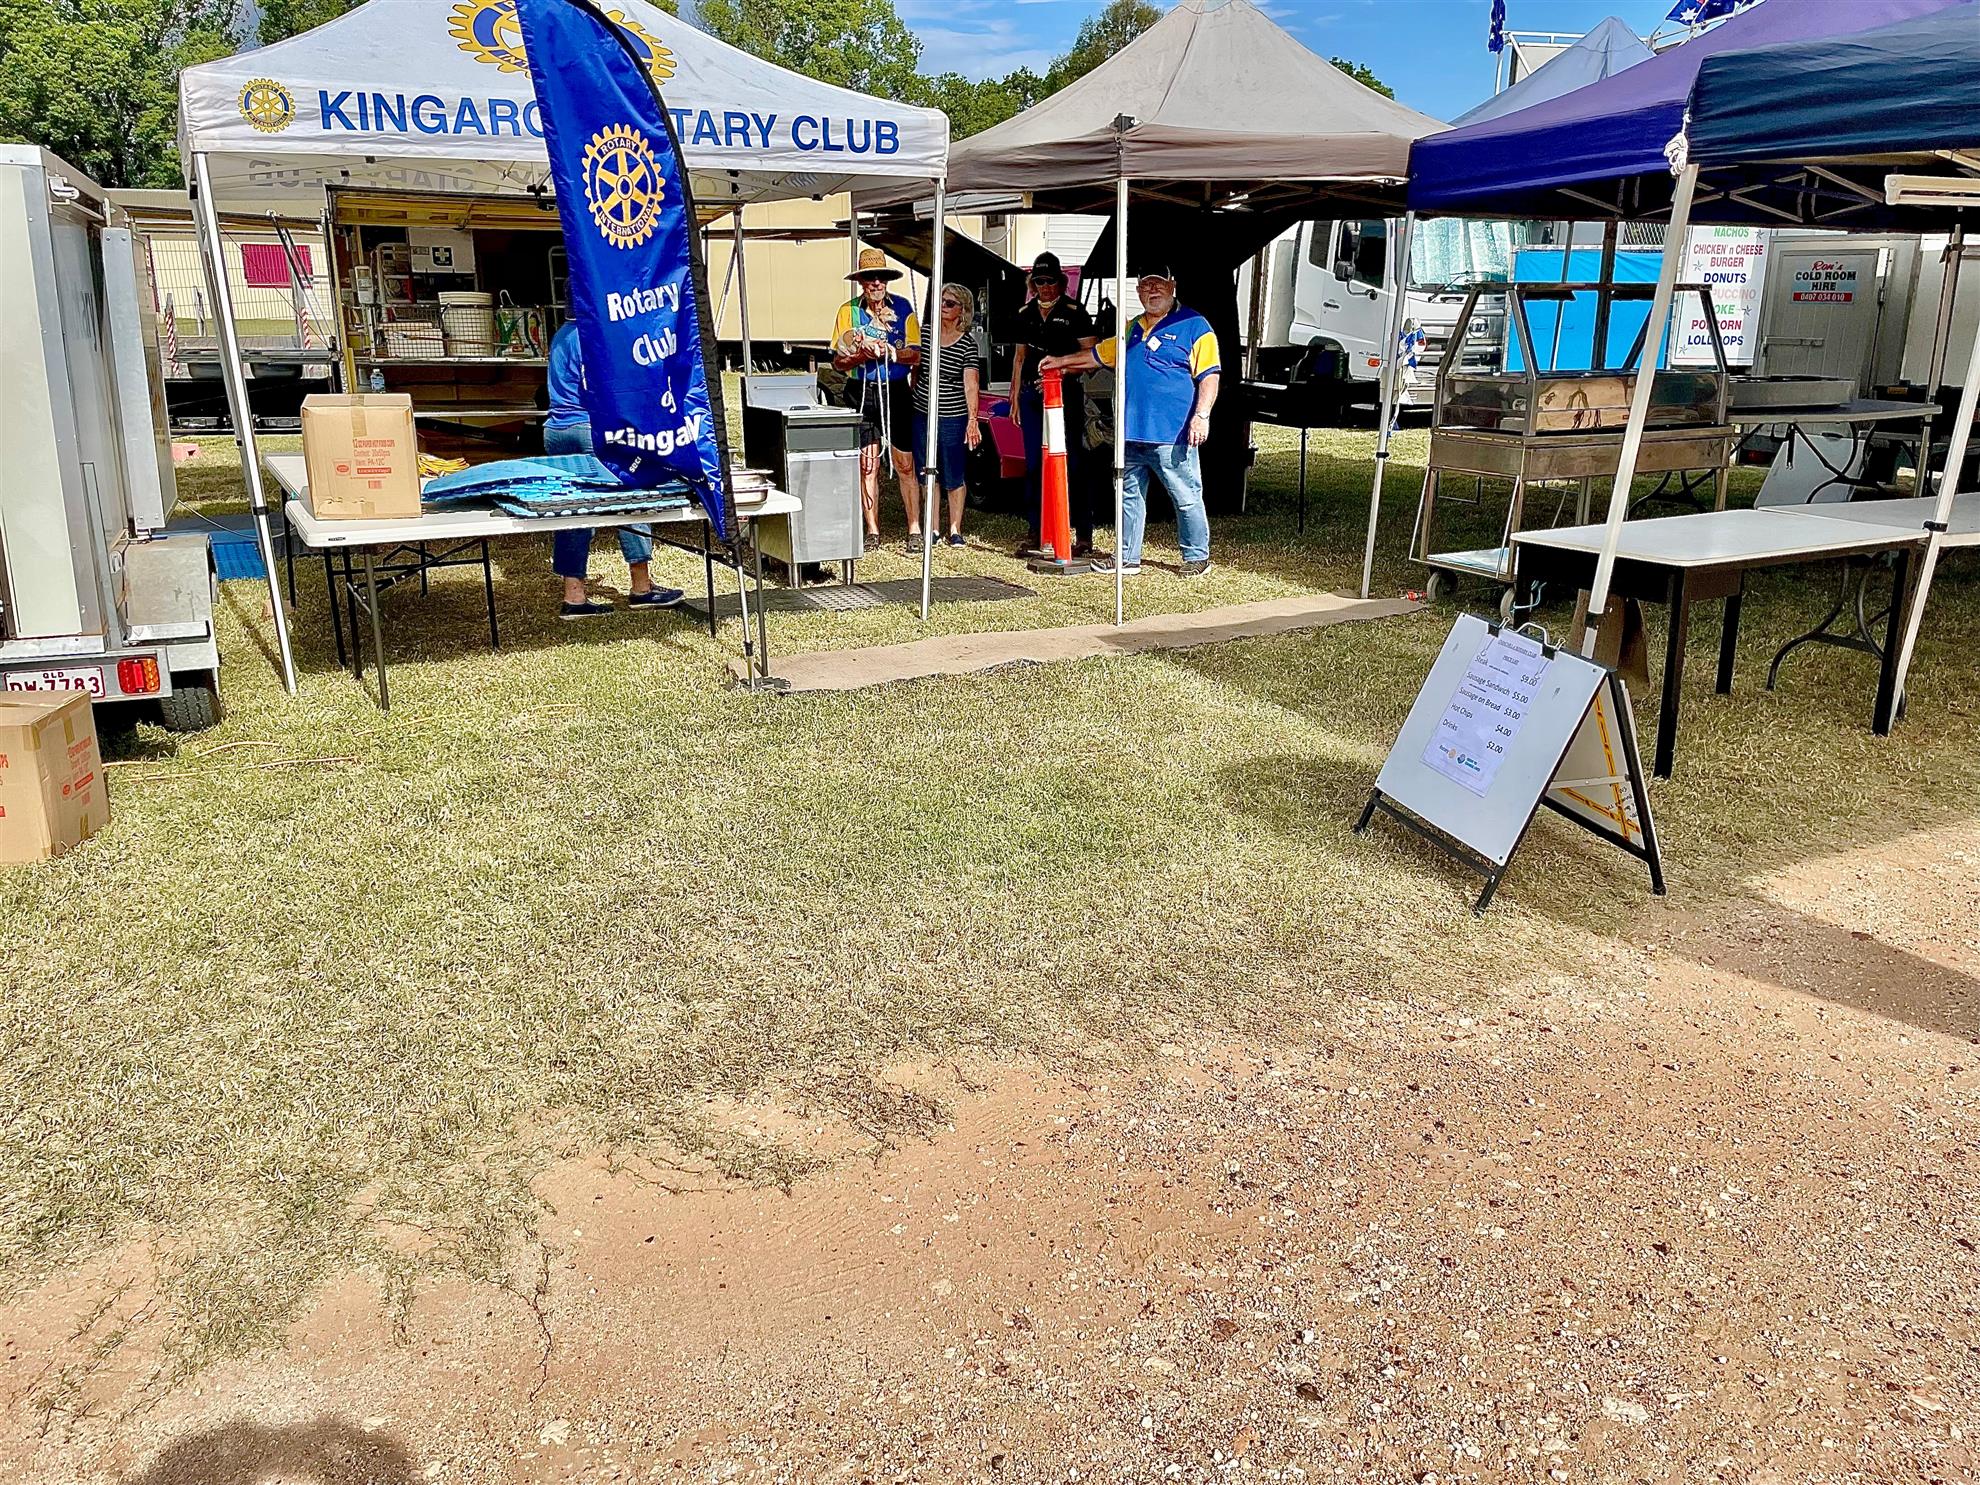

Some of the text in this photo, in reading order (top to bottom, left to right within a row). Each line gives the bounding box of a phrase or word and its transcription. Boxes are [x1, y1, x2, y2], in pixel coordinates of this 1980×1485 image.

[318, 90, 900, 155] KINGARO TARY CLUB
[601, 137, 638, 156] ROTARY
[598, 198, 655, 238] INTERNATIONAL
[1714, 228, 1750, 238] NACHOS
[1736, 244, 1764, 255] CHEESE
[1710, 257, 1744, 267] BURGER
[1812, 261, 1843, 271] Ron's
[1704, 273, 1746, 283] DONUTS
[1796, 271, 1856, 280] COLD ROOM
[1812, 282, 1836, 291] HIRE
[606, 282, 680, 322] Rotary
[1714, 305, 1735, 314] OKE
[1691, 320, 1742, 330] POORN
[632, 327, 677, 366] Club
[1688, 336, 1744, 345] LOLLOPS
[1474, 656, 1537, 686] Steak $9.00
[1466, 672, 1486, 686] Sausage
[1486, 680, 1510, 696] Sandwich
[1512, 691, 1529, 703] $5.00
[1459, 687, 1478, 701] Sausage
[1484, 698, 1501, 711] Bread
[1504, 708, 1520, 720] $3.00
[1451, 703, 1512, 737] Hot Chips $4.00
[1442, 719, 1503, 753] Drinks $2.00
